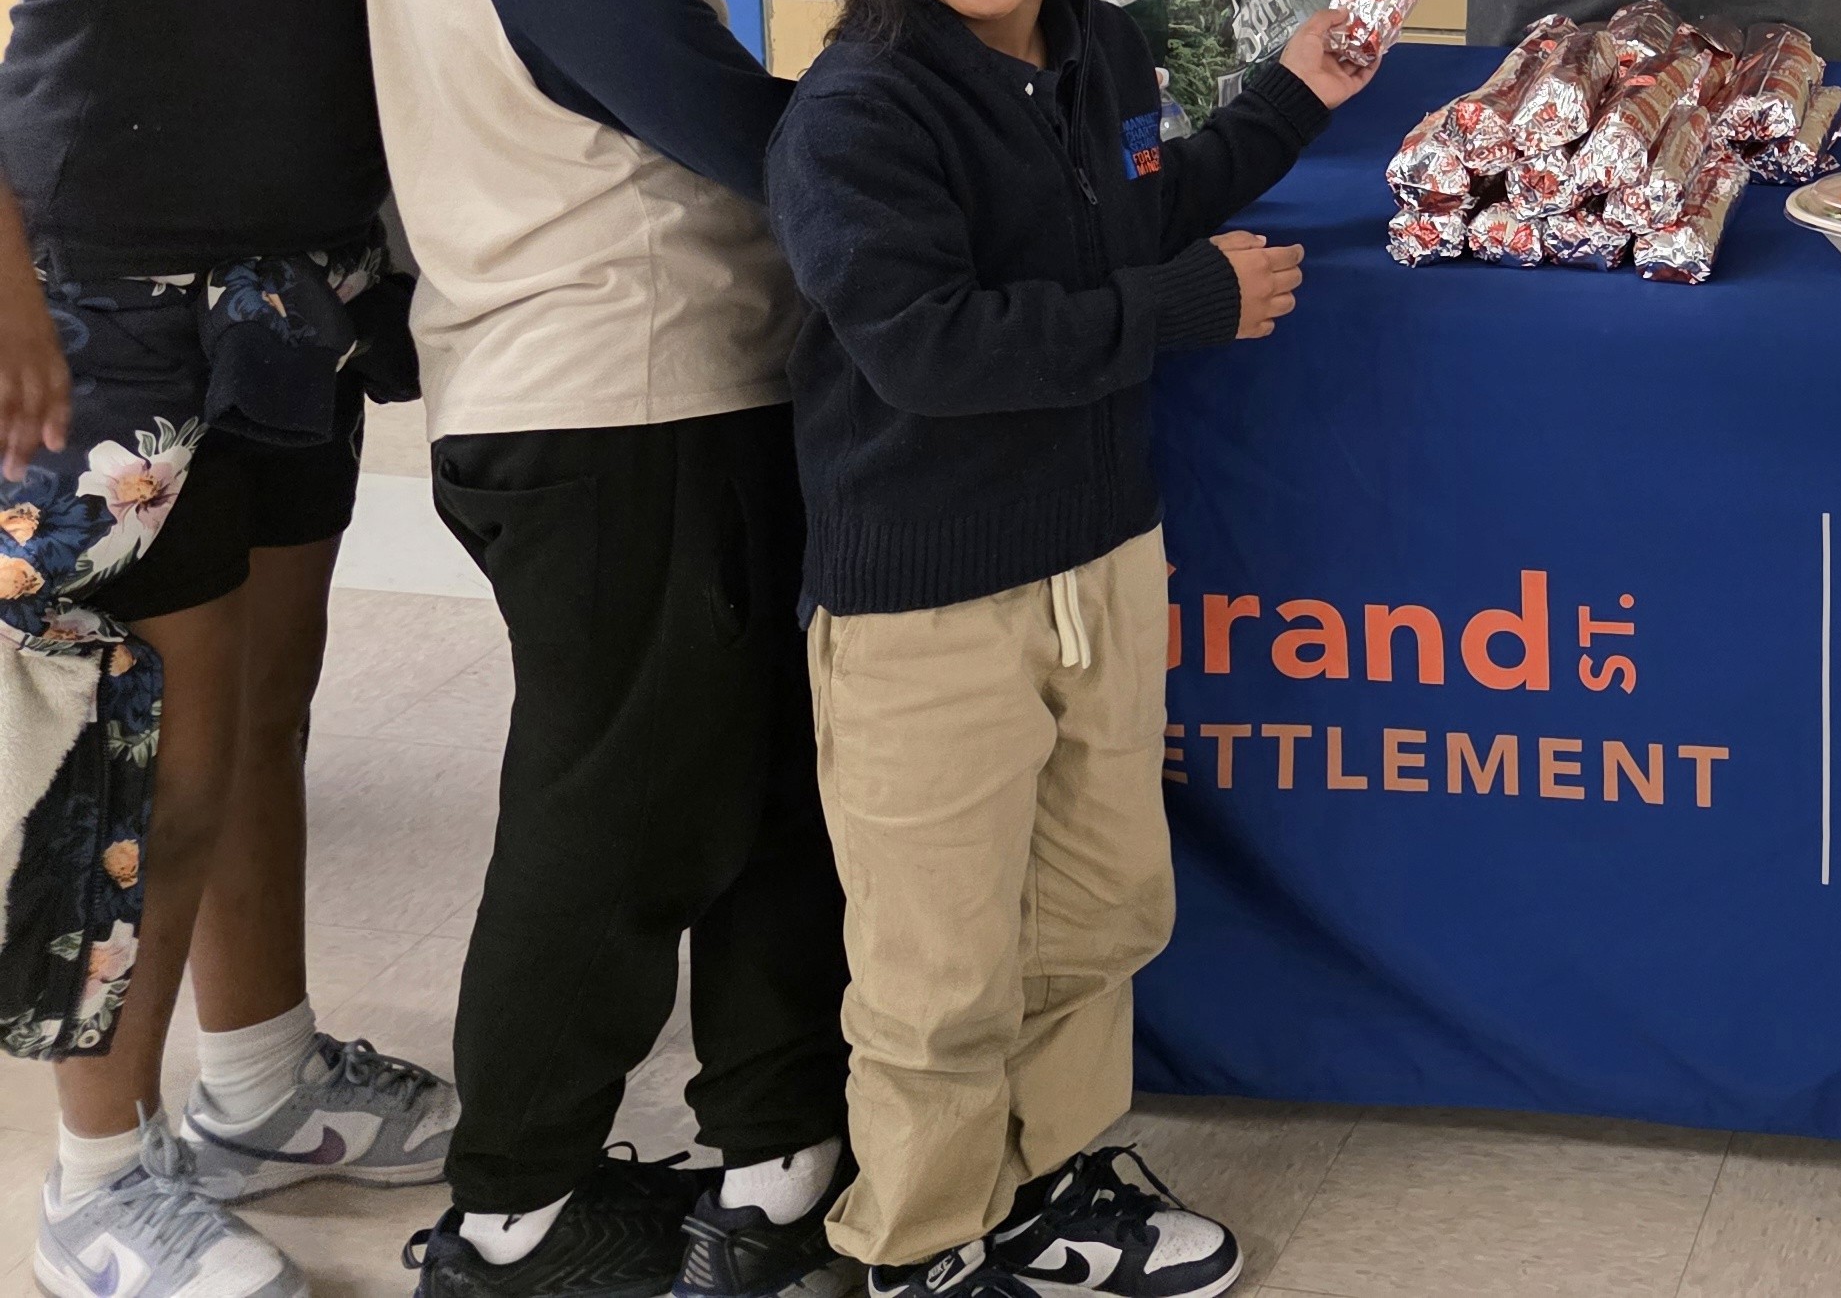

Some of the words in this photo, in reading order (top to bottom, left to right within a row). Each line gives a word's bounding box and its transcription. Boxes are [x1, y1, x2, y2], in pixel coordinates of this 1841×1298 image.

[1166, 562, 1550, 691] rand
[1578, 593, 1638, 694] ST.
[1163, 723, 1730, 808] ETTLEMENT
